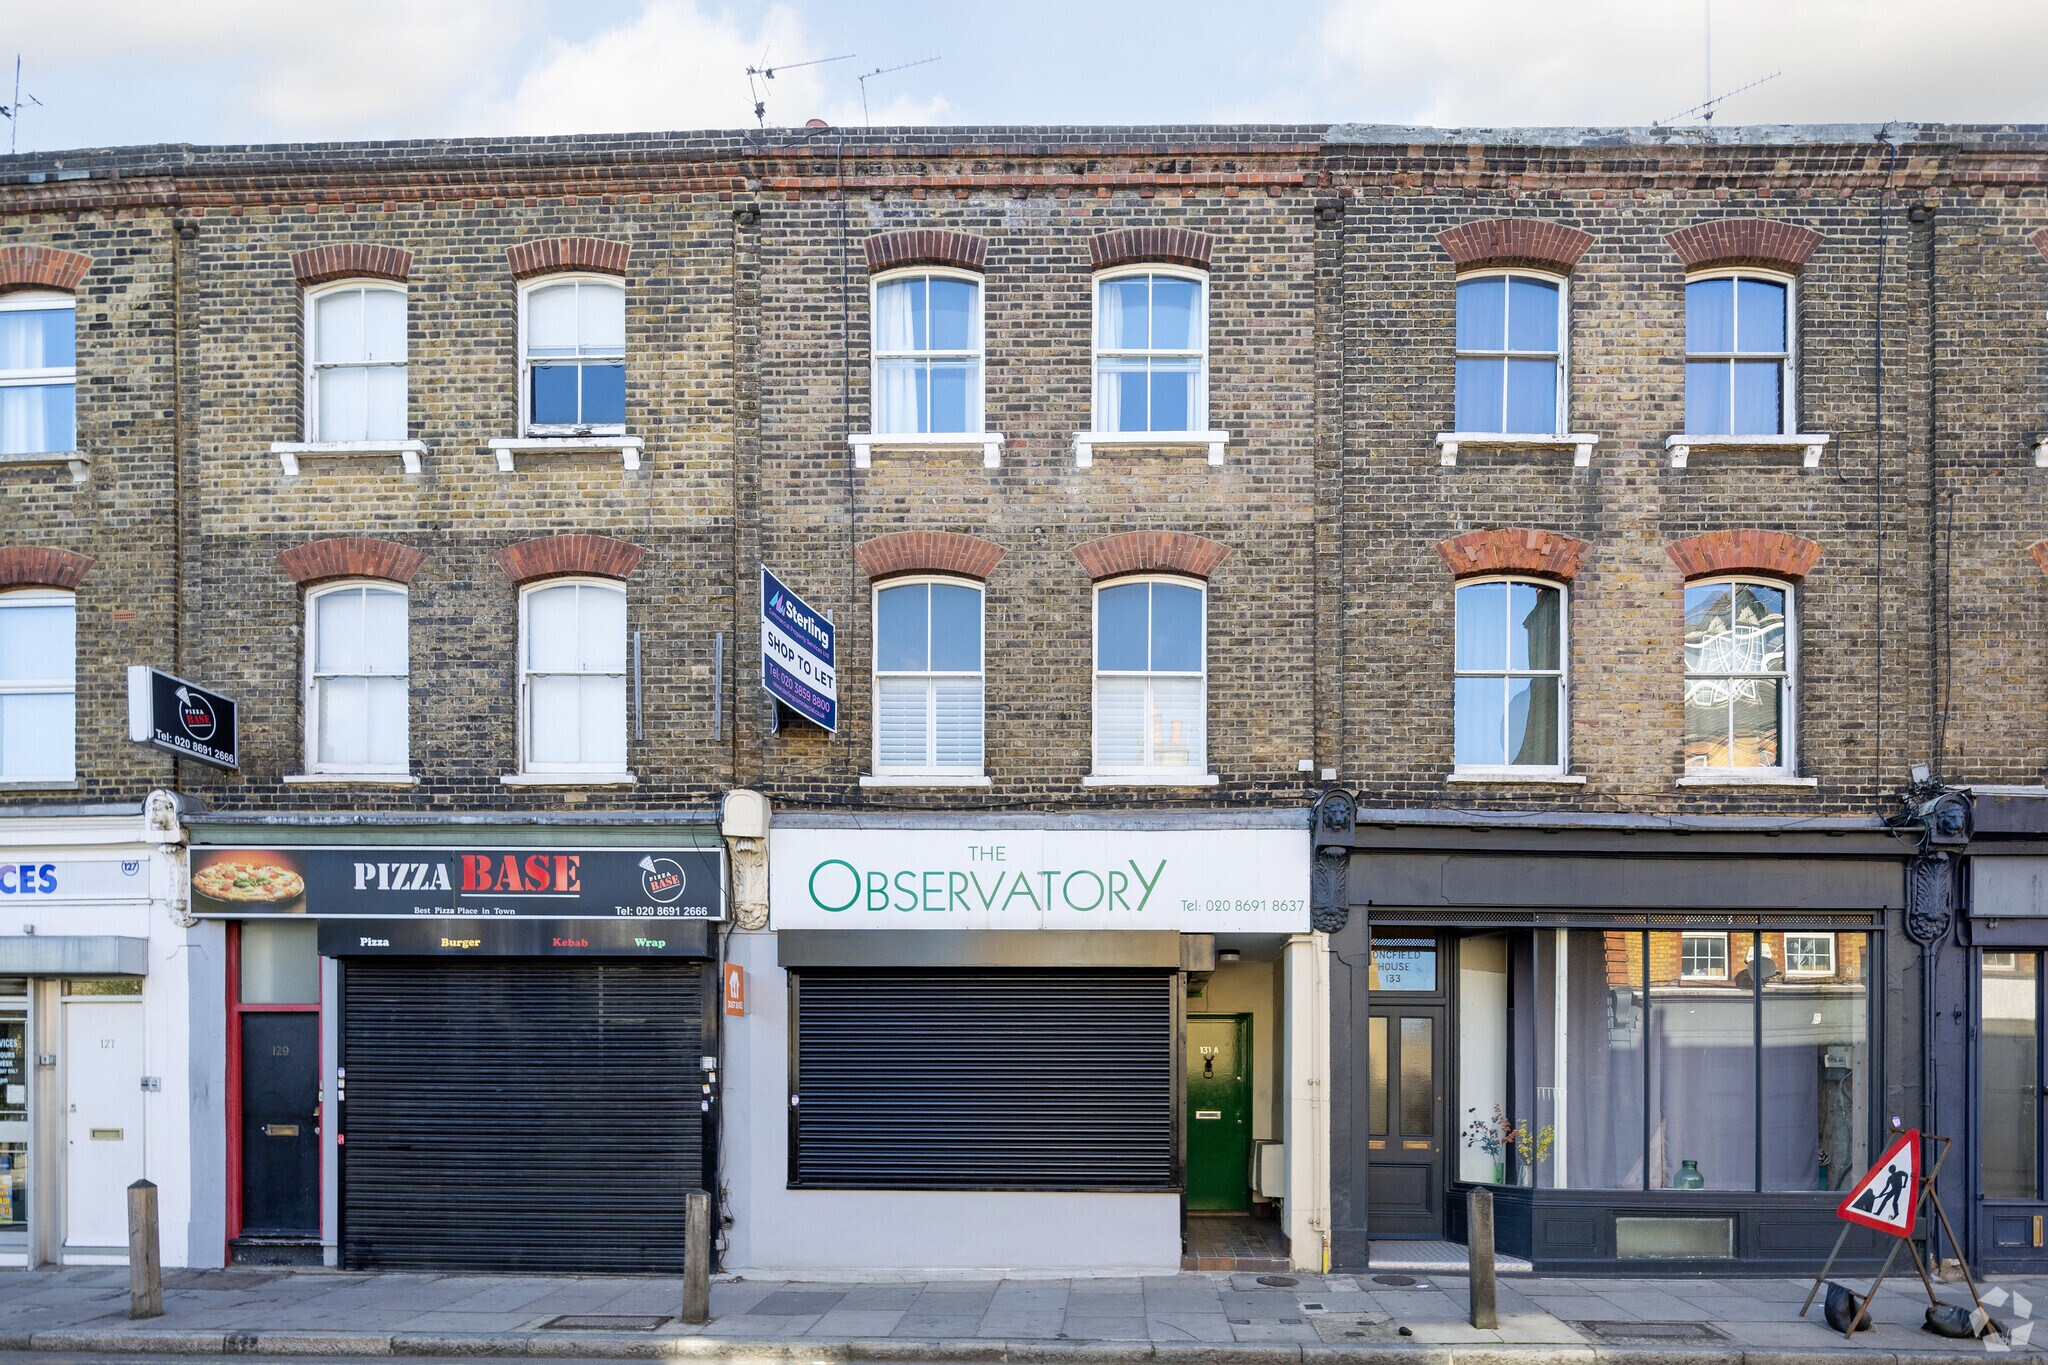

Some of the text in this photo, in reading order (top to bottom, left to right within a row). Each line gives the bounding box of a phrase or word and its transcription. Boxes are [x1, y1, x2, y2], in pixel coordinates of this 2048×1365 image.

[786, 600, 829, 649] Sterling
[822, 649, 830, 659] Ltd
[768, 631, 833, 689] SHOP TO LET
[769, 662, 830, 712] Tel: 020 3859 8800
[186, 715, 211, 724] BASE
[155, 728, 234, 763] Tel: 020 8691 2666
[968, 846, 1006, 861] THE
[123, 862, 137, 871] 127
[353, 854, 580, 891] PIZZA BASE
[649, 872, 671, 881] PIZZA
[0, 864, 57, 894] CES
[650, 874, 680, 891] BASE
[808, 859, 1167, 912] OBSERVATORY
[482, 907, 490, 915] in
[493, 907, 516, 915] Town
[615, 906, 708, 916] Tel: 020 8691 2666
[1181, 900, 1305, 911] Tel: 020 8691 8637
[360, 937, 390, 947] Pizza
[441, 937, 481, 949] Burger
[552, 937, 589, 947] Kebab
[634, 937, 666, 949] Wrap
[1378, 962, 1411, 971] HOUSE
[1385, 974, 1401, 983] 133
[100, 1039, 115, 1049] 127
[272, 1045, 290, 1056] 129
[1200, 1046, 1219, 1054] 131 A
